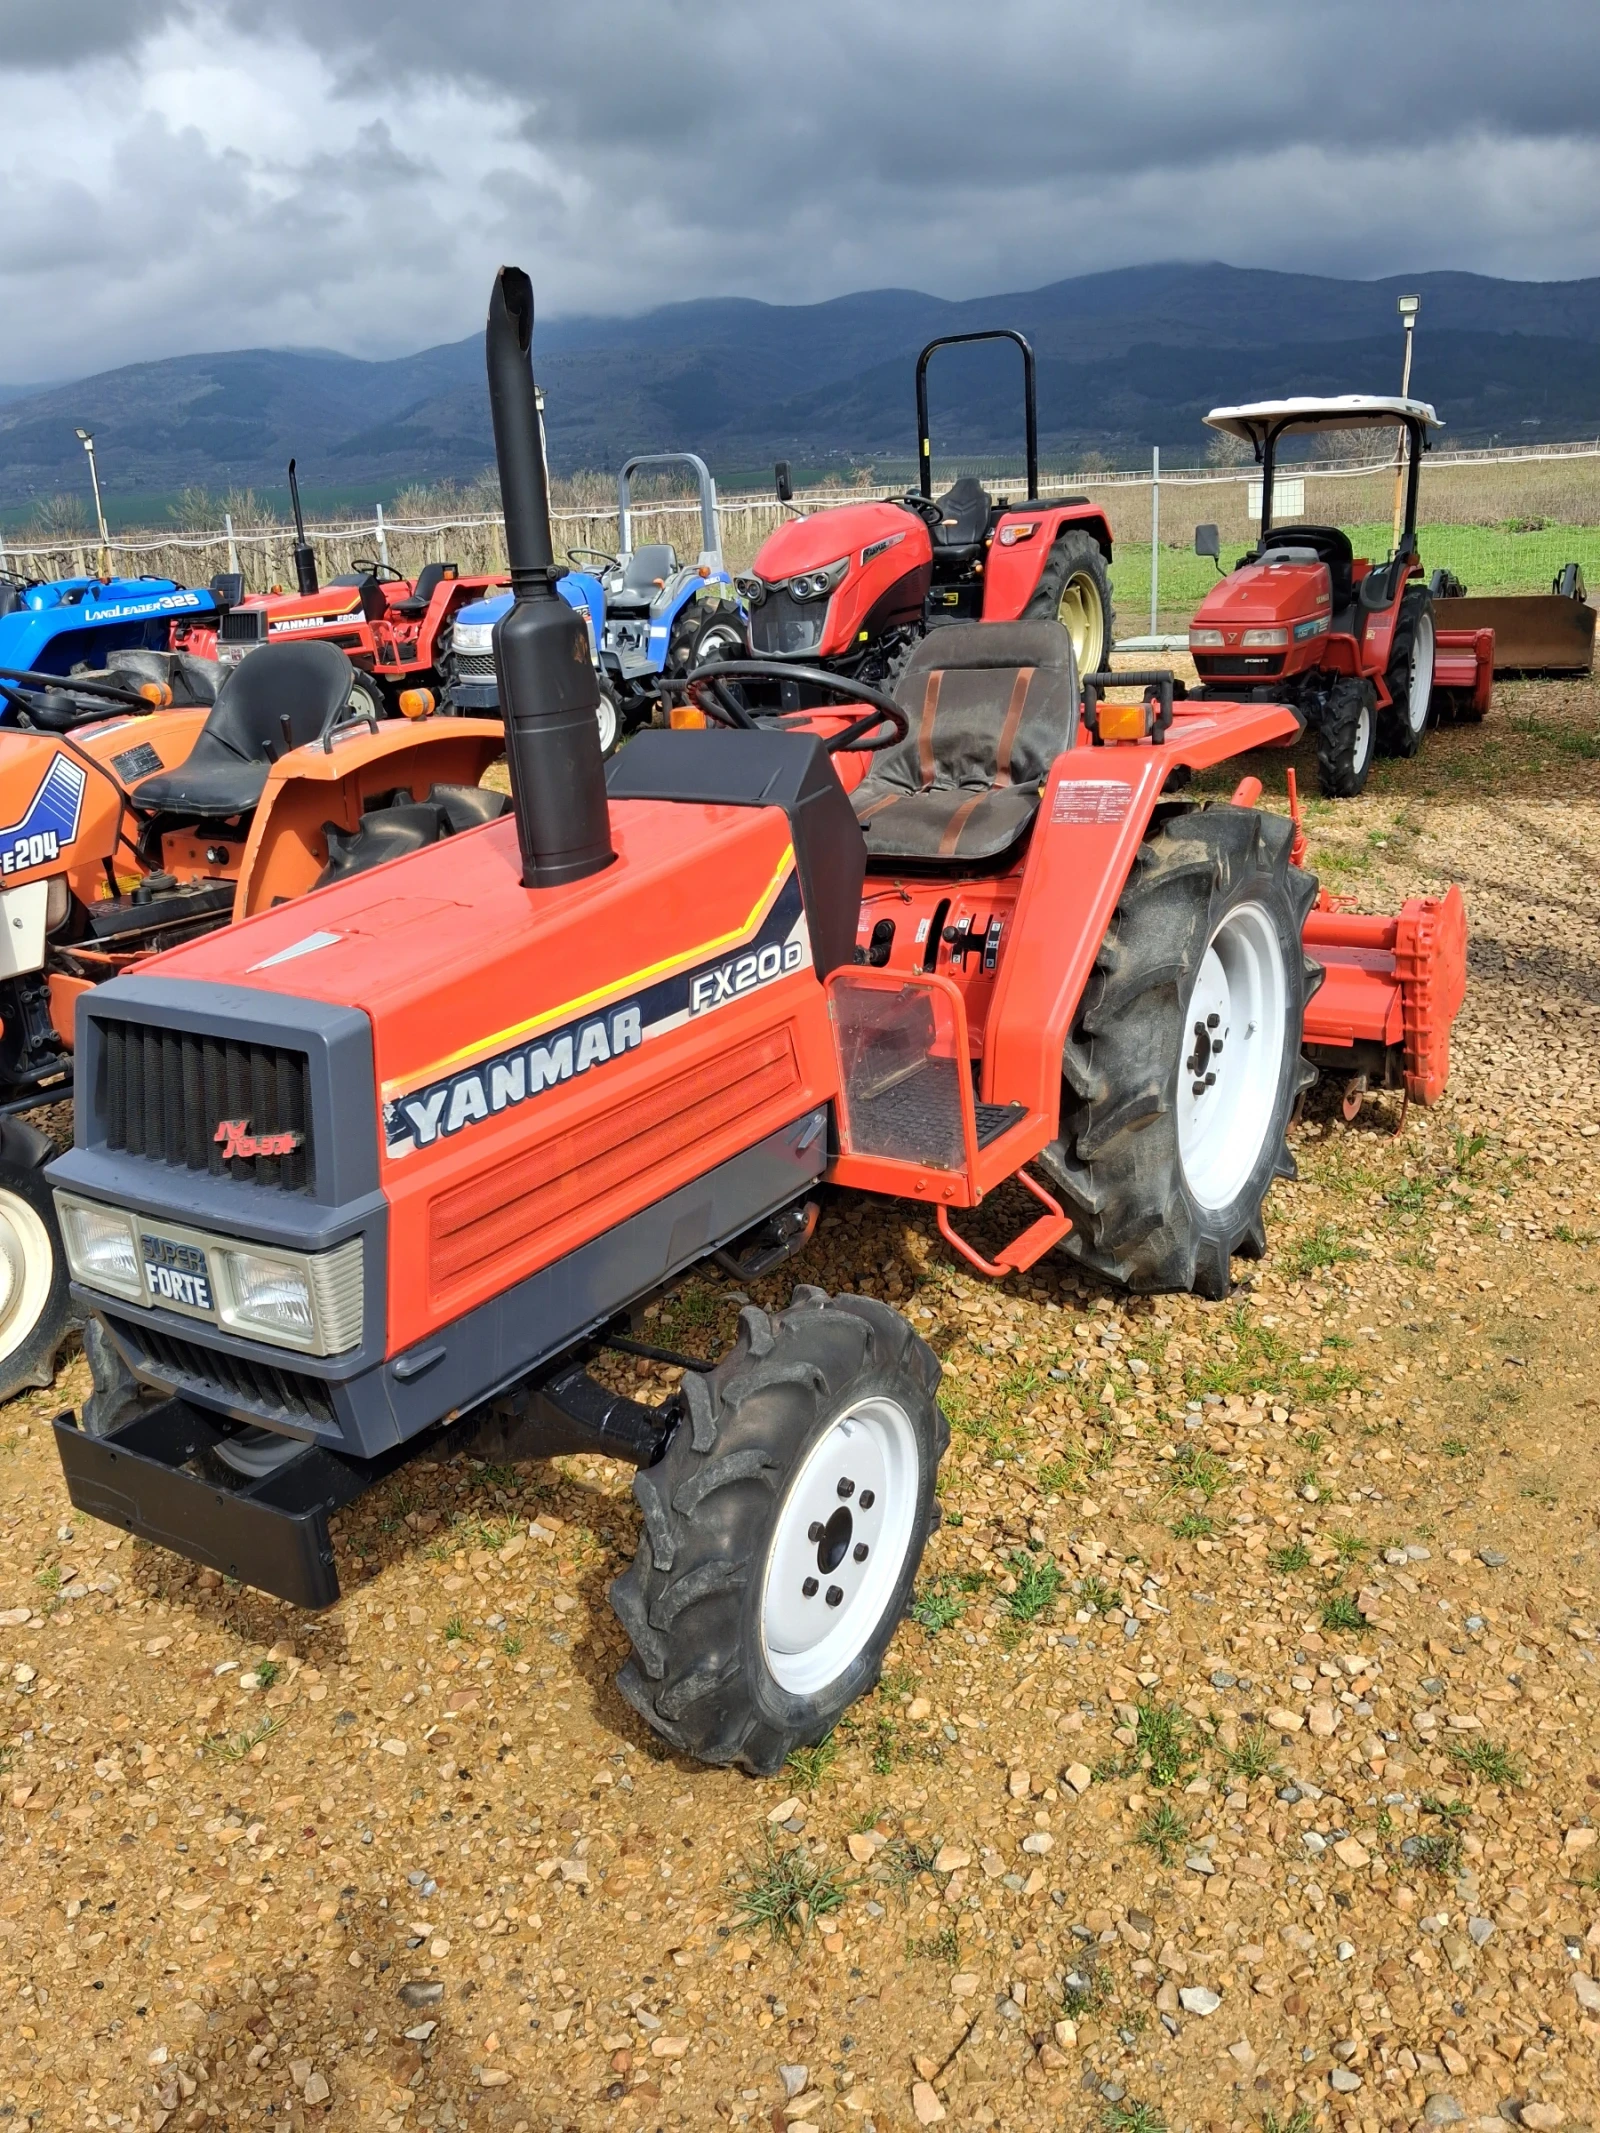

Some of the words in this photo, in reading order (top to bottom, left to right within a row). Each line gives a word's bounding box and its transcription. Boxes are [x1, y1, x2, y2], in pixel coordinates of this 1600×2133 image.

[159, 593, 200, 609] 325
[274, 616, 324, 632] YANMAR
[0, 831, 59, 874] E204
[403, 1004, 643, 1146] YANMAR
[691, 941, 802, 1013] FX20D
[141, 1234, 207, 1273] SUPER
[145, 1262, 210, 1309] FORTE
